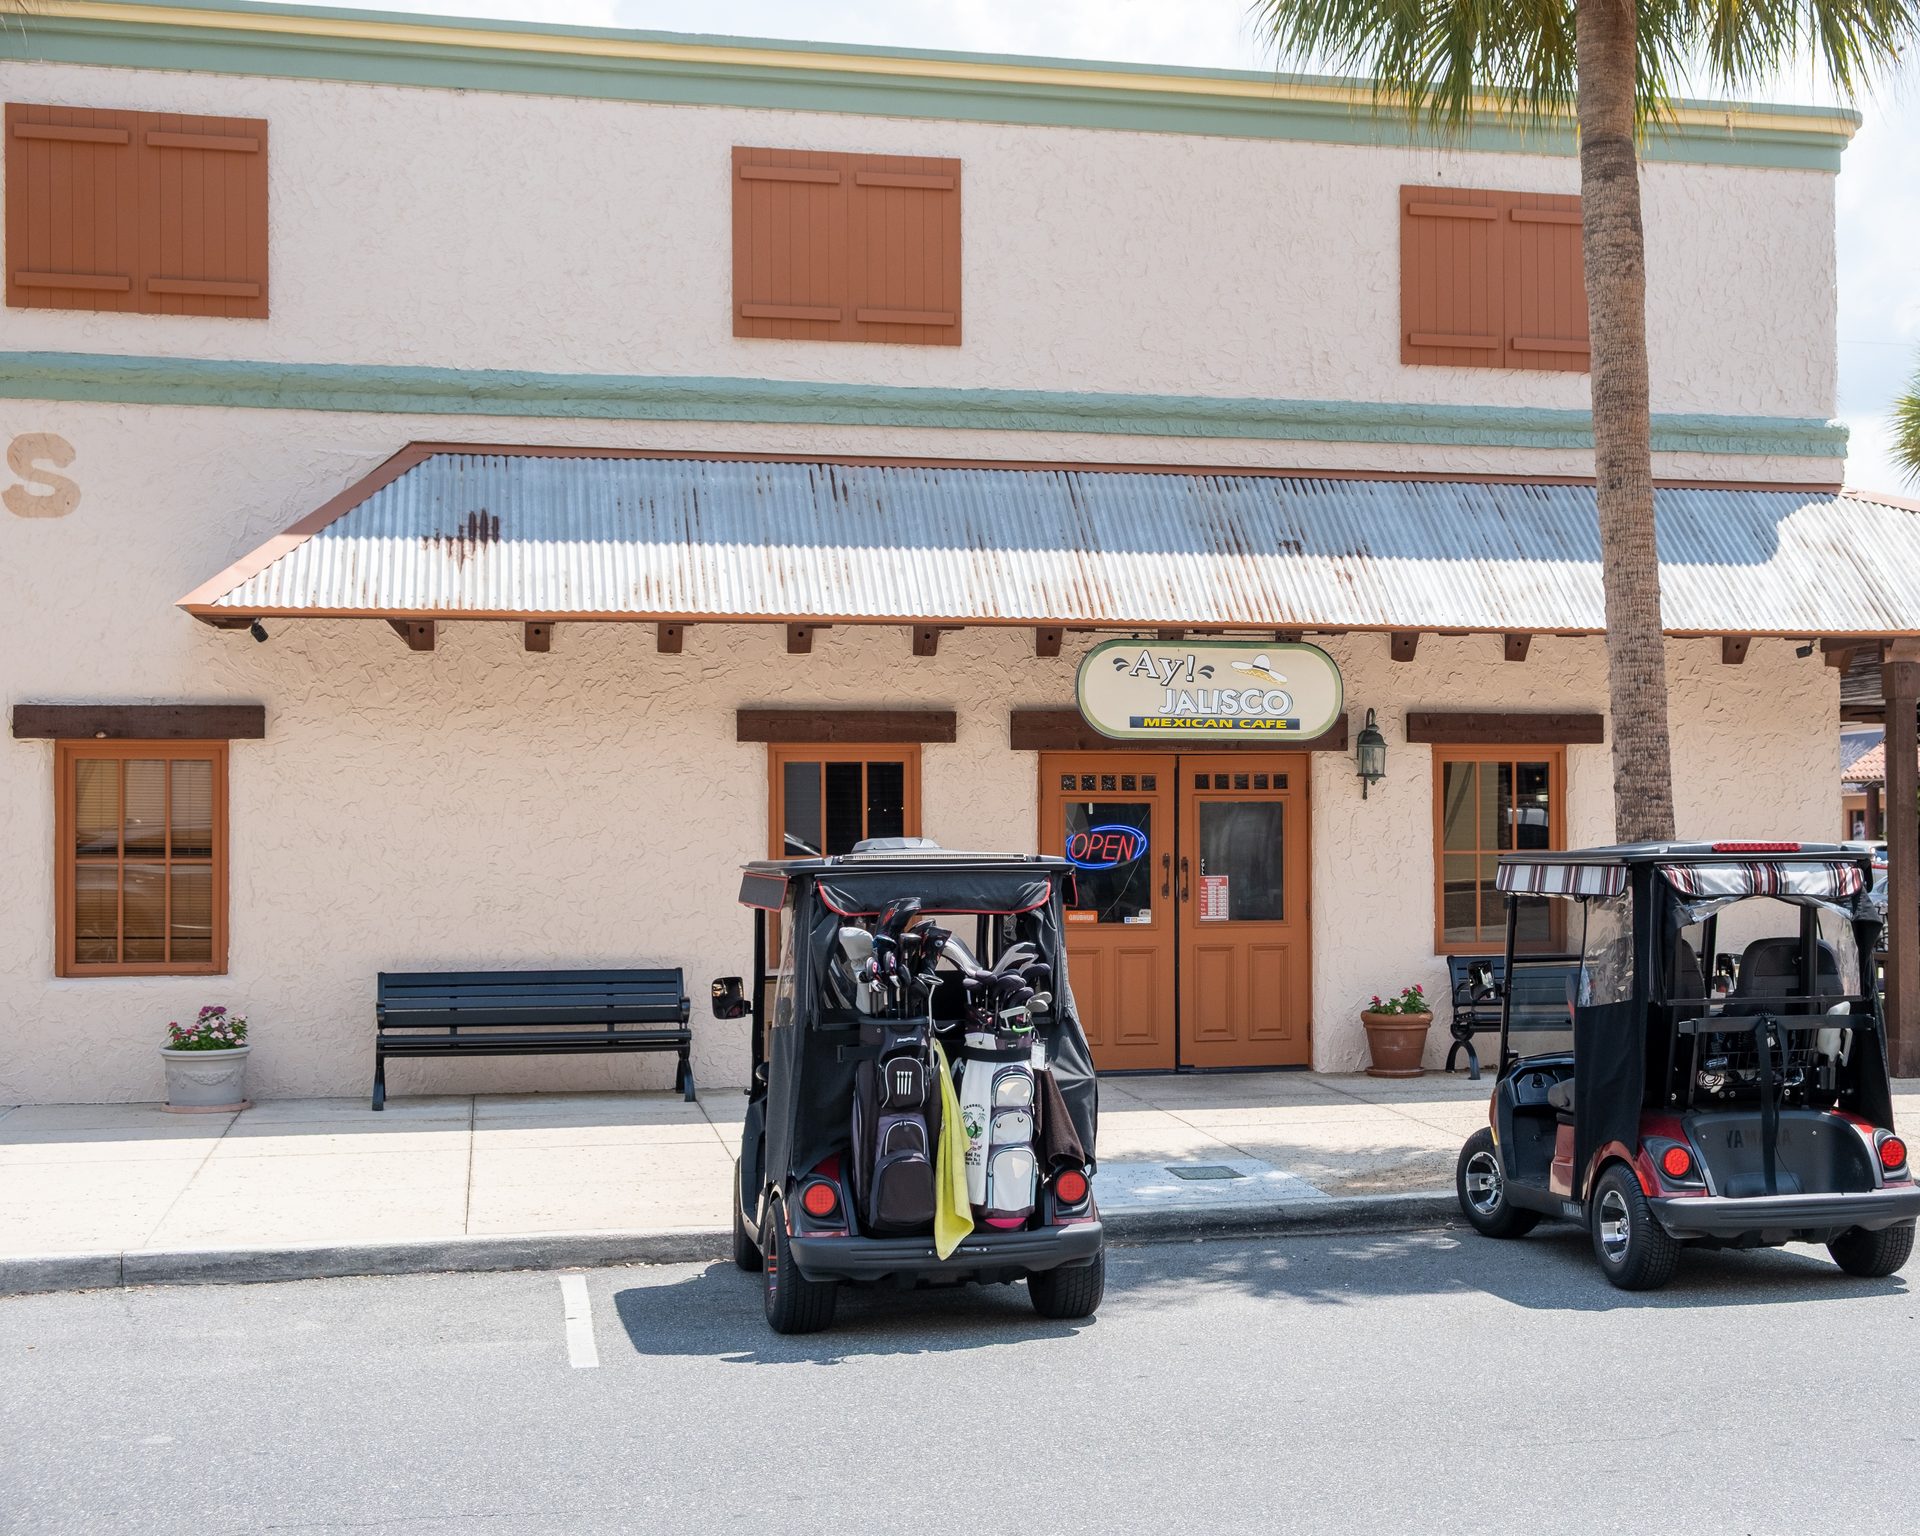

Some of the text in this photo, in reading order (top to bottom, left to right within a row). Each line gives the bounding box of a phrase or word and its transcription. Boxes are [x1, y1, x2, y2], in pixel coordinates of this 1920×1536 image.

[1, 432, 81, 518] S
[1129, 650, 1196, 685] Ay!
[1158, 688, 1293, 716] JALISCO
[1143, 717, 1287, 729] MEXICAN CAFE
[1070, 833, 1135, 861] OPEN
